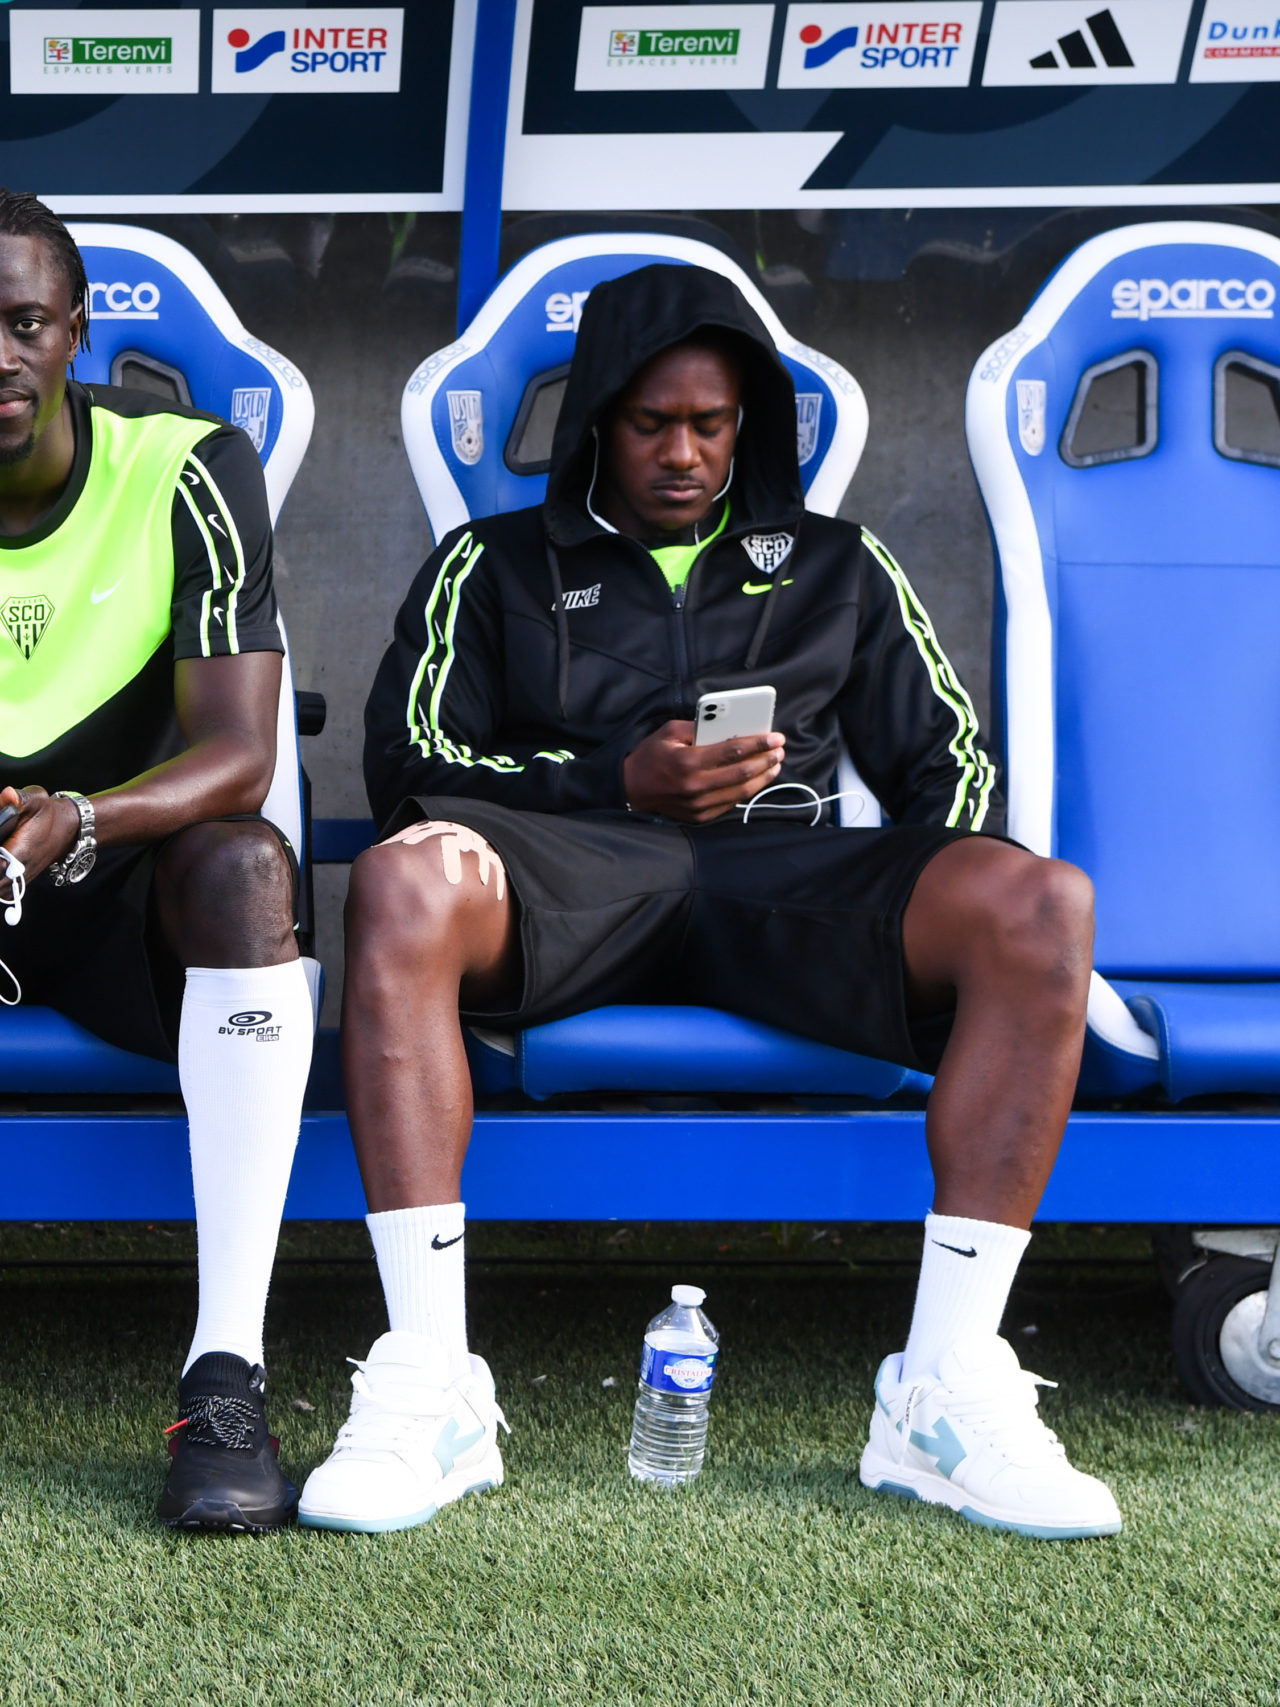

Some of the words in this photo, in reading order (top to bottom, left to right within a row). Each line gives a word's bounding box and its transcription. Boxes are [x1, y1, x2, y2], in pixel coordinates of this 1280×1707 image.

[293, 28, 388, 49] INTER
[645, 32, 734, 54] Terenvi
[865, 23, 963, 44] INTER
[79, 40, 166, 61] Terenvi
[860, 46, 959, 68] SPORT
[43, 66, 112, 74] ESPACES
[124, 66, 173, 74] VERTS
[291, 51, 387, 73] SPORT
[607, 58, 677, 67] ESPACES
[689, 57, 738, 66] VERTS
[1111, 279, 1276, 320] sparco
[245, 338, 303, 388] sparco
[408, 343, 466, 393] sparco
[235, 393, 266, 418] USLD
[751, 538, 786, 554] SCO
[9, 604, 45, 622] SCO
[218, 1026, 235, 1035] BV
[237, 1026, 282, 1035] SPORT
